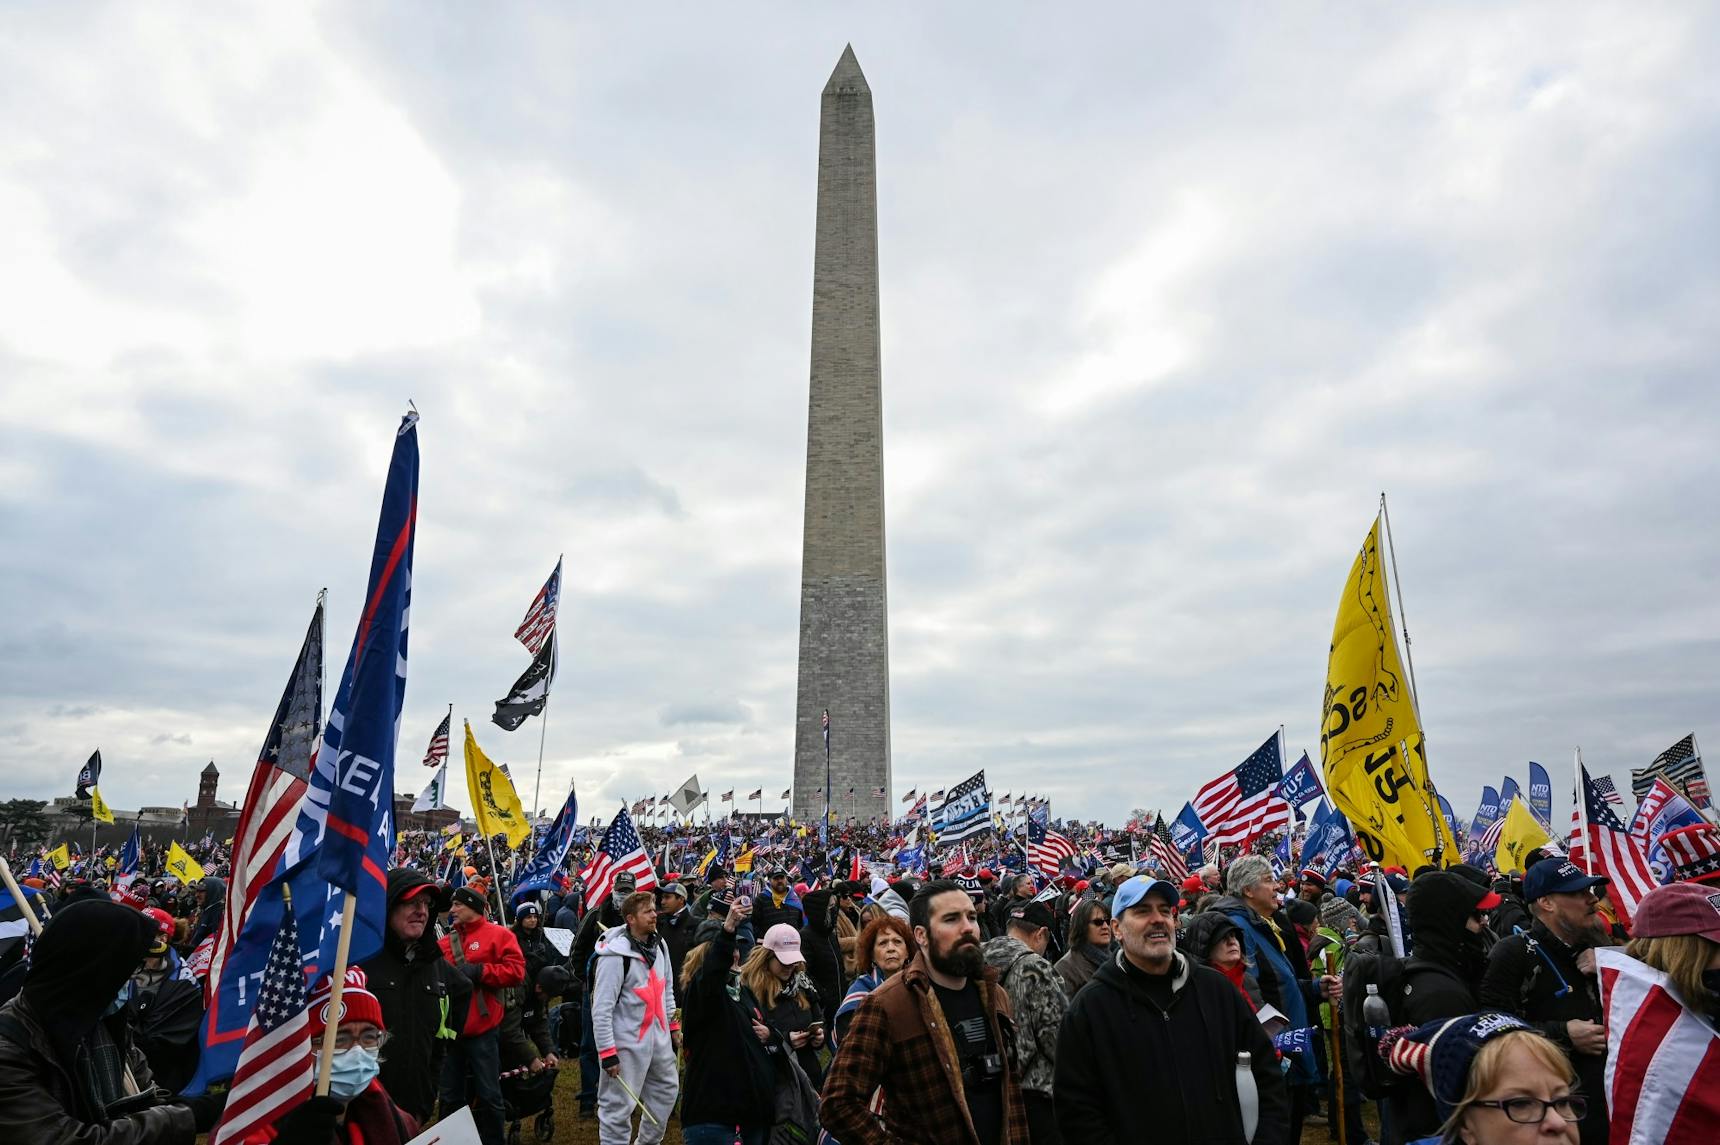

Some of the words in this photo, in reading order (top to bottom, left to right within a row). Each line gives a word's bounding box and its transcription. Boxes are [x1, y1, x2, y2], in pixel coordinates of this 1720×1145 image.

[1531, 784, 1548, 793] NTD
[1480, 803, 1498, 813] NTD
[1443, 814, 1453, 822] TD
